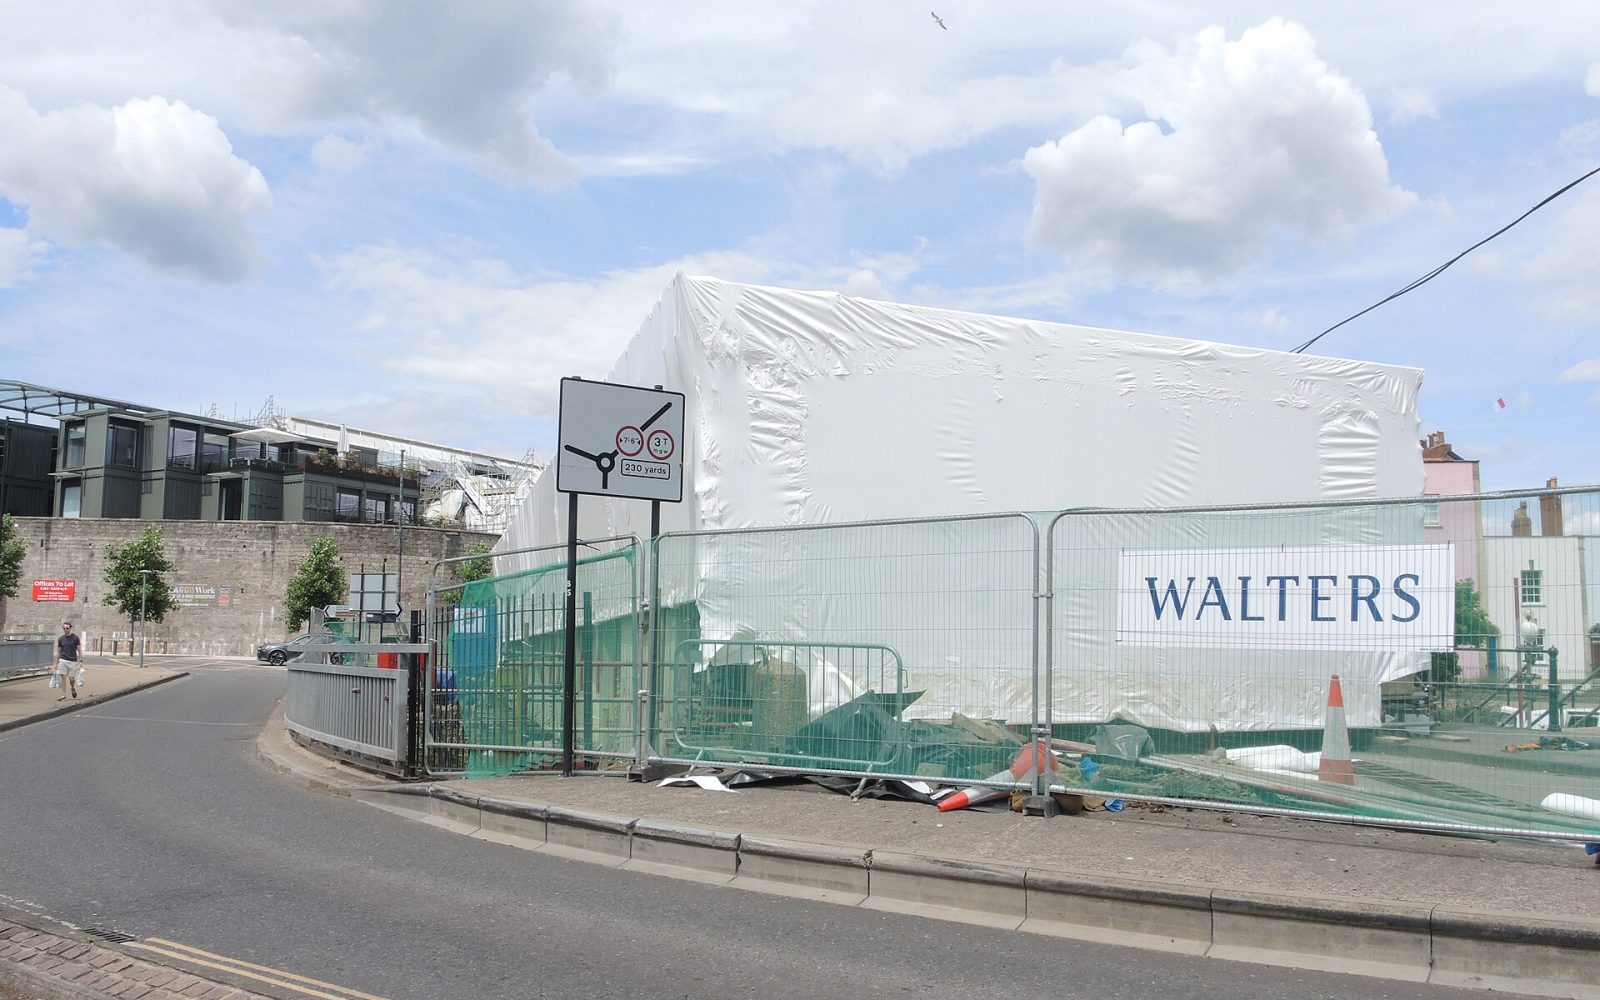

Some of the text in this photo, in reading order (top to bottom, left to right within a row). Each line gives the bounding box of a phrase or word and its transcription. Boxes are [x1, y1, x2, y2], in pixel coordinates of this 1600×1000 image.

[625, 463, 667, 475] 230 yards
[195, 586, 216, 594] Work
[1144, 573, 1421, 623] WALTERS
